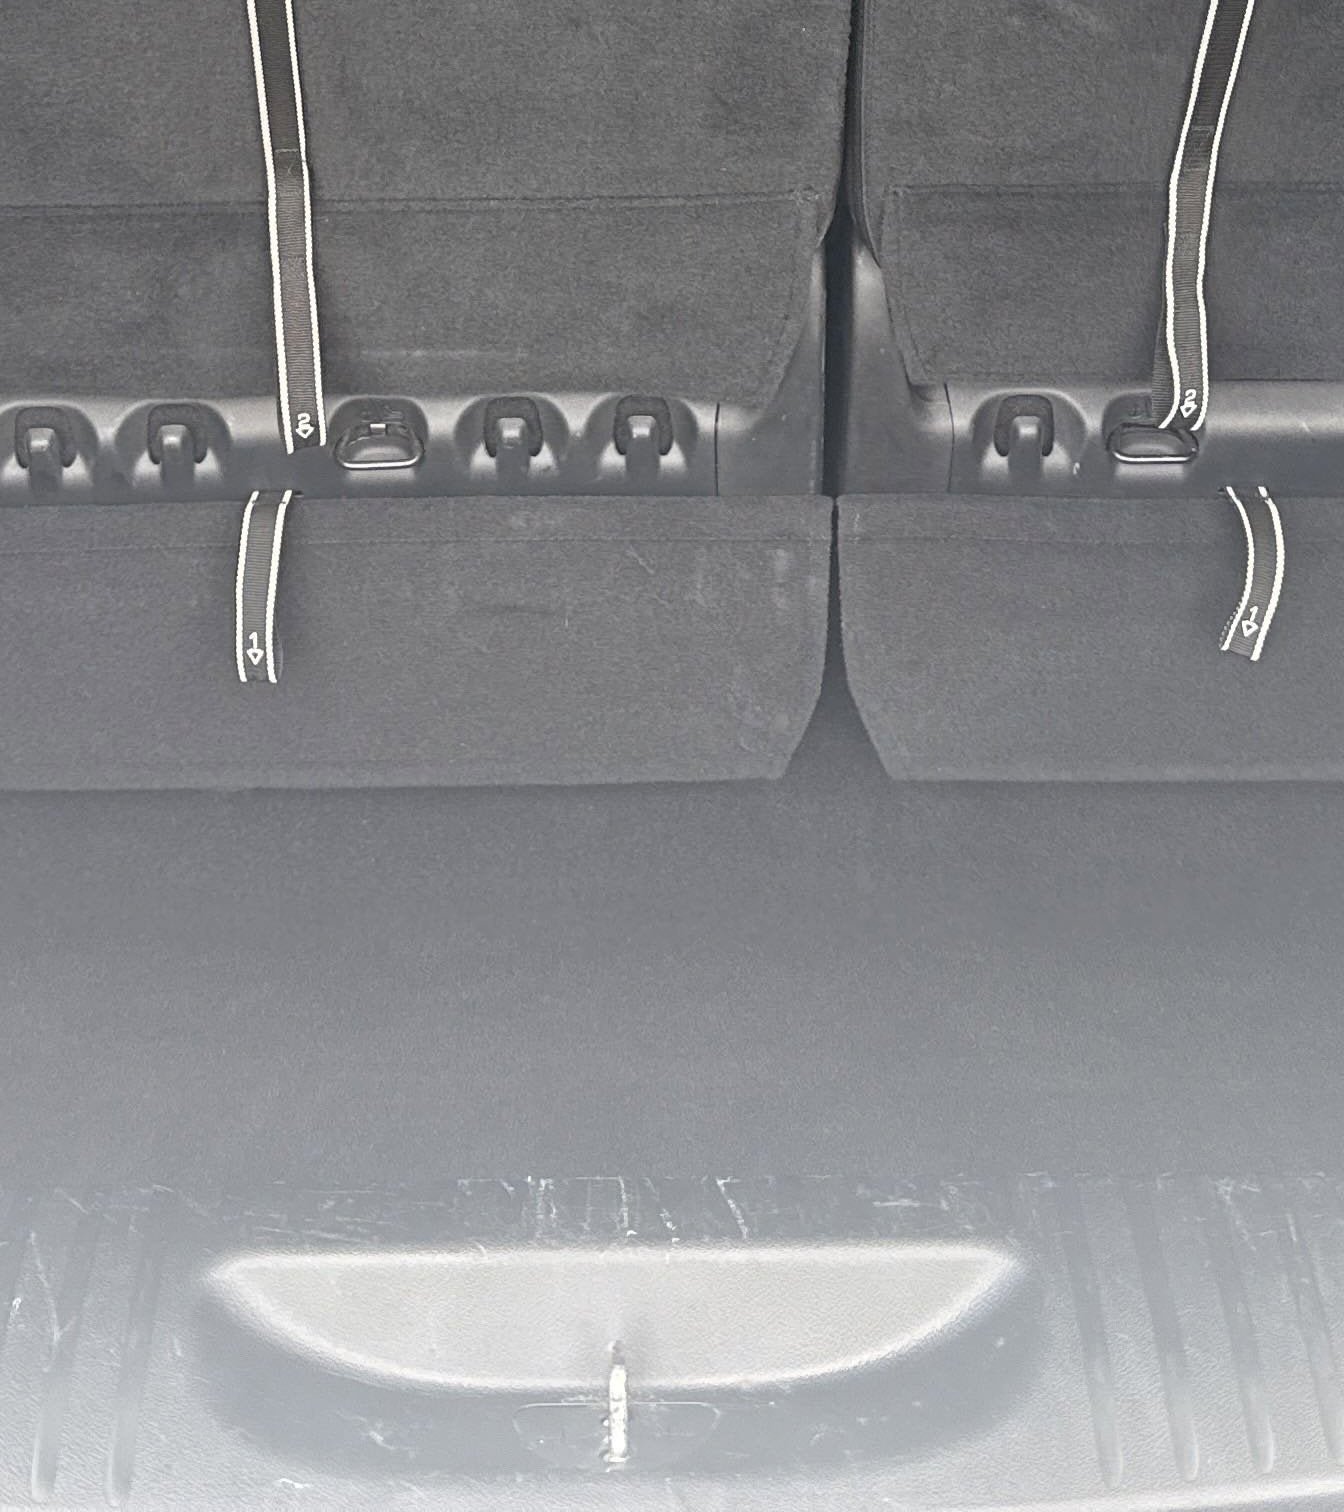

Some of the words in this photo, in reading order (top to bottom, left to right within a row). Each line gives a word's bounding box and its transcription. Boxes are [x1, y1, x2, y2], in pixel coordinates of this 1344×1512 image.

[1185, 388, 1197, 405] 2
[297, 412, 311, 429] 2
[1249, 605, 1259, 622] 1
[248, 631, 258, 649] 1
